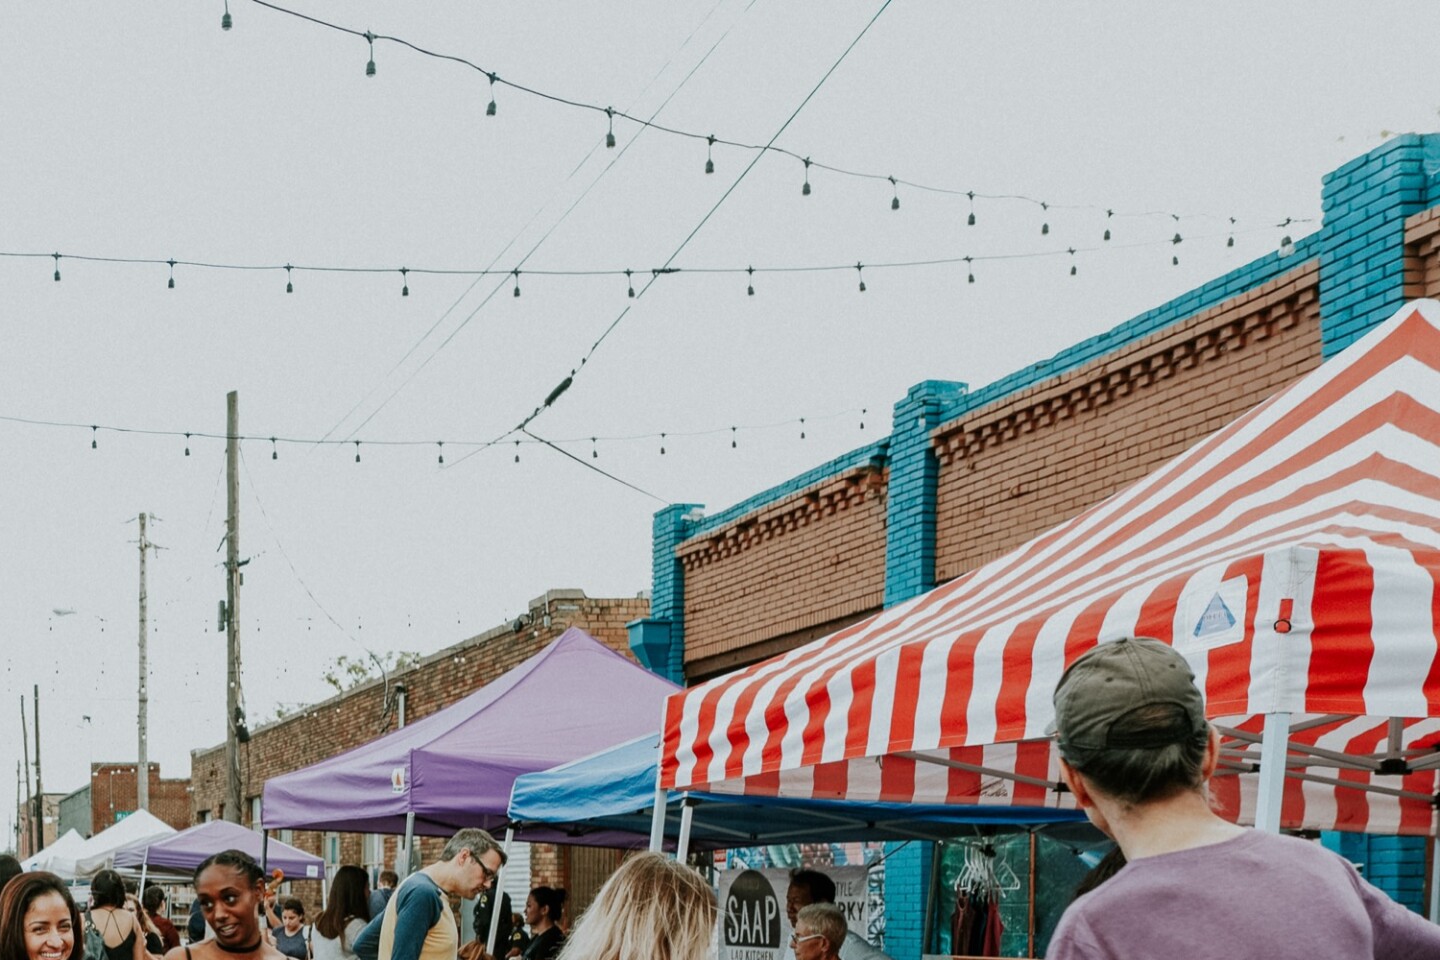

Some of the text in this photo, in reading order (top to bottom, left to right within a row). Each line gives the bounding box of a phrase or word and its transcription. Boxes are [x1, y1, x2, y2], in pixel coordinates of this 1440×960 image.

[835, 881, 853, 897] TYLE
[728, 895, 777, 944] SAAP
[841, 901, 865, 922] RKY
[730, 949, 743, 960] LAO
